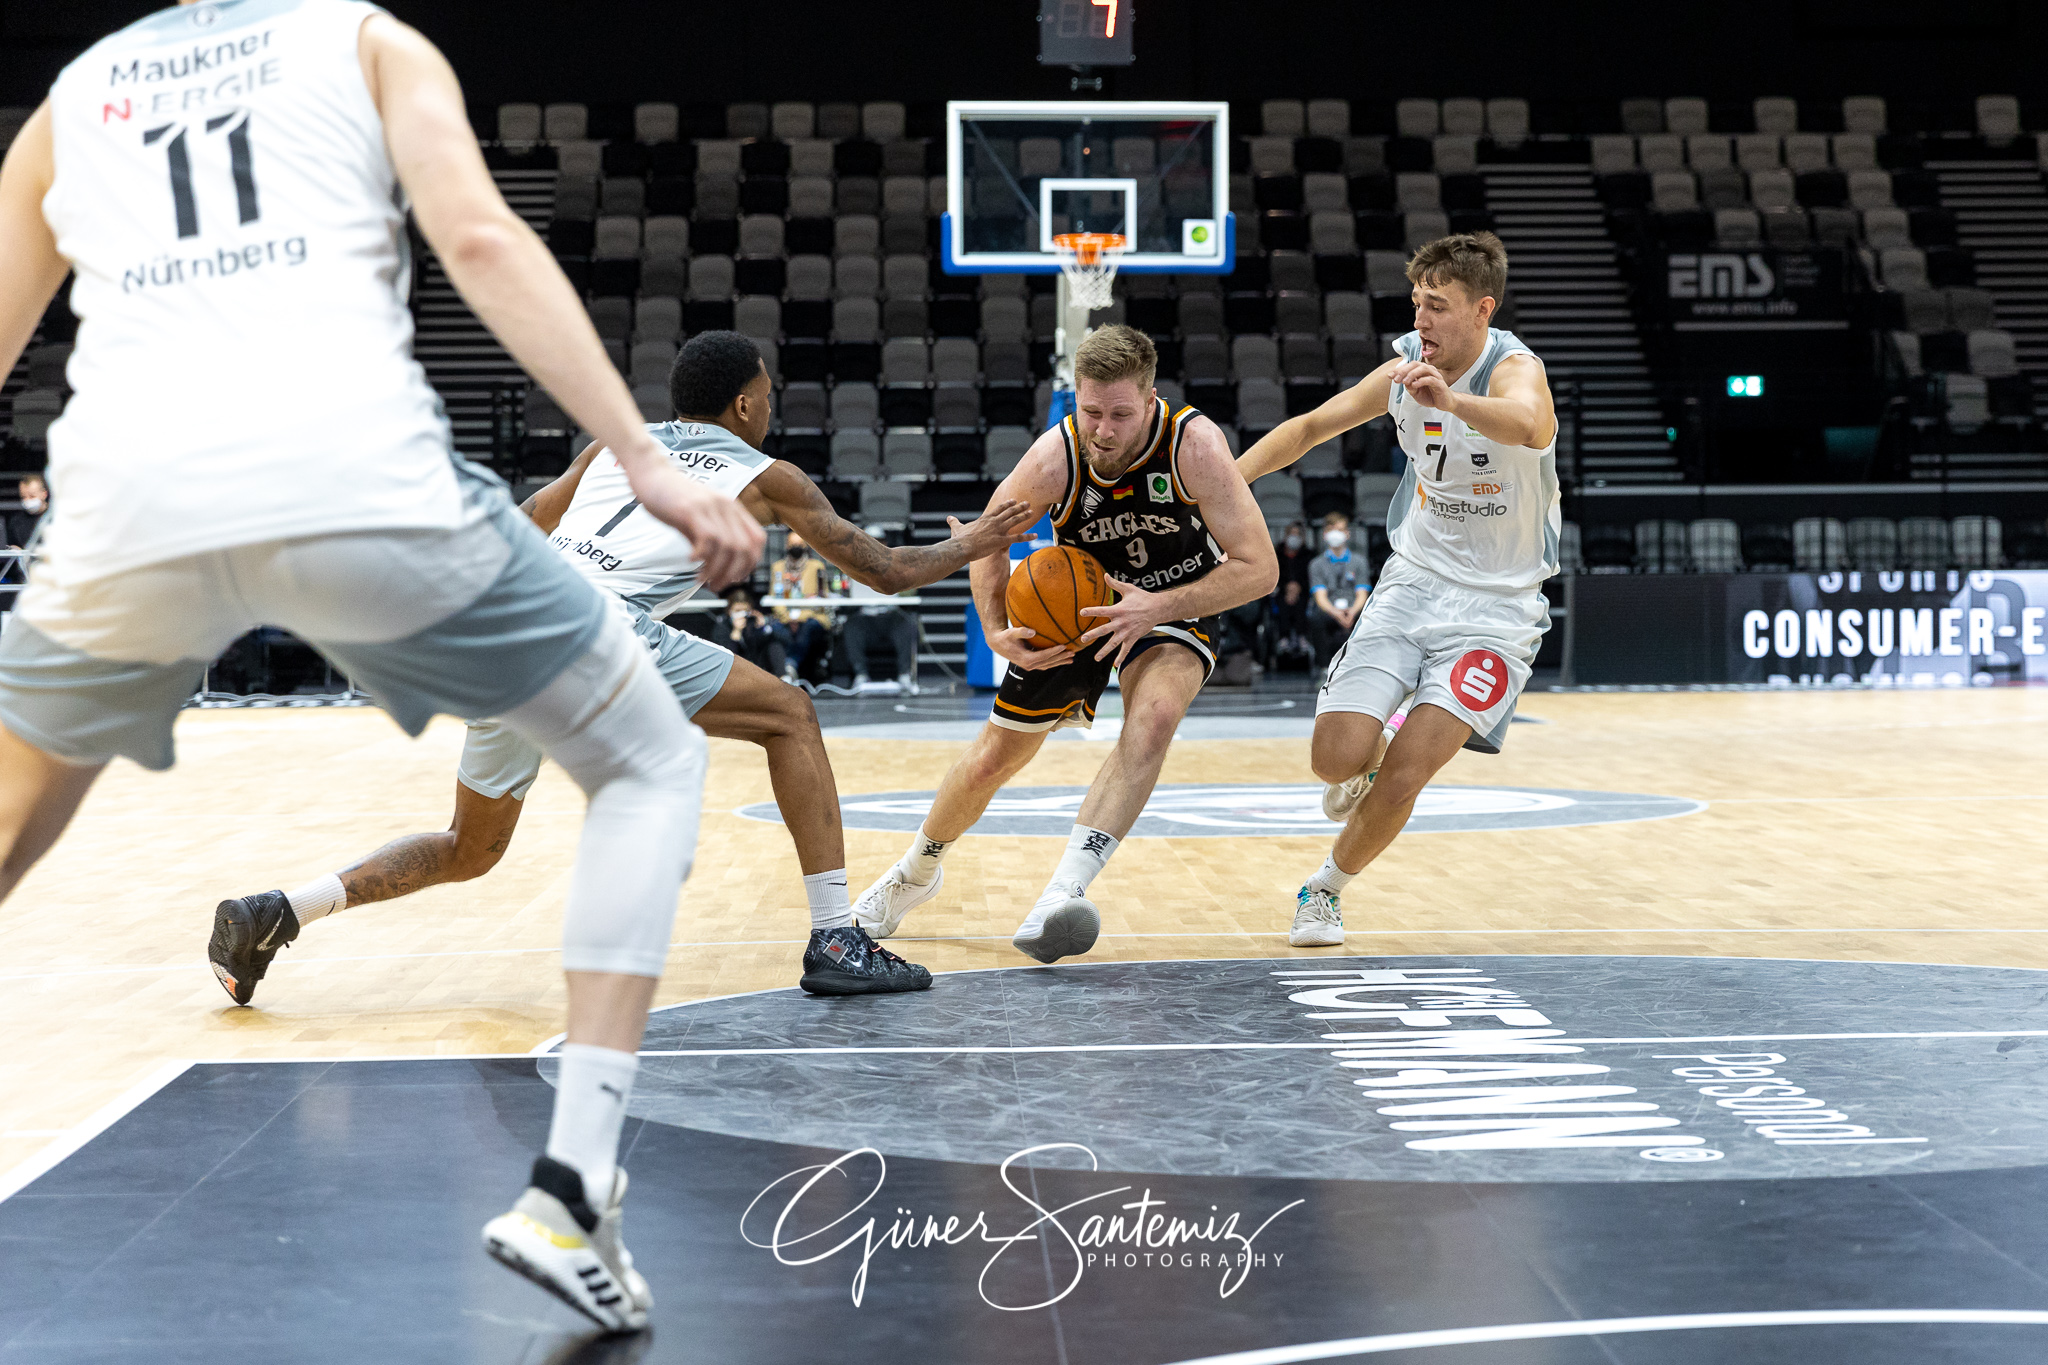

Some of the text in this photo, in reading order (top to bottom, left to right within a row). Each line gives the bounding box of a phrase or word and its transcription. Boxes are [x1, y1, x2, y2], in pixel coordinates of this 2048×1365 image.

[1091, 0, 1119, 38] 7
[110, 29, 276, 87] Maukner
[143, 107, 261, 240] 11
[122, 236, 307, 293] Nürnberg
[1667, 252, 1776, 298] EMS
[669, 451, 729, 474] ayer
[1425, 443, 1448, 482] 7
[1078, 511, 1181, 543] EAGLES
[1125, 536, 1149, 569] 9
[1743, 605, 2047, 659] CONSUMER-E
[1081, 829, 1113, 858] PEAK
